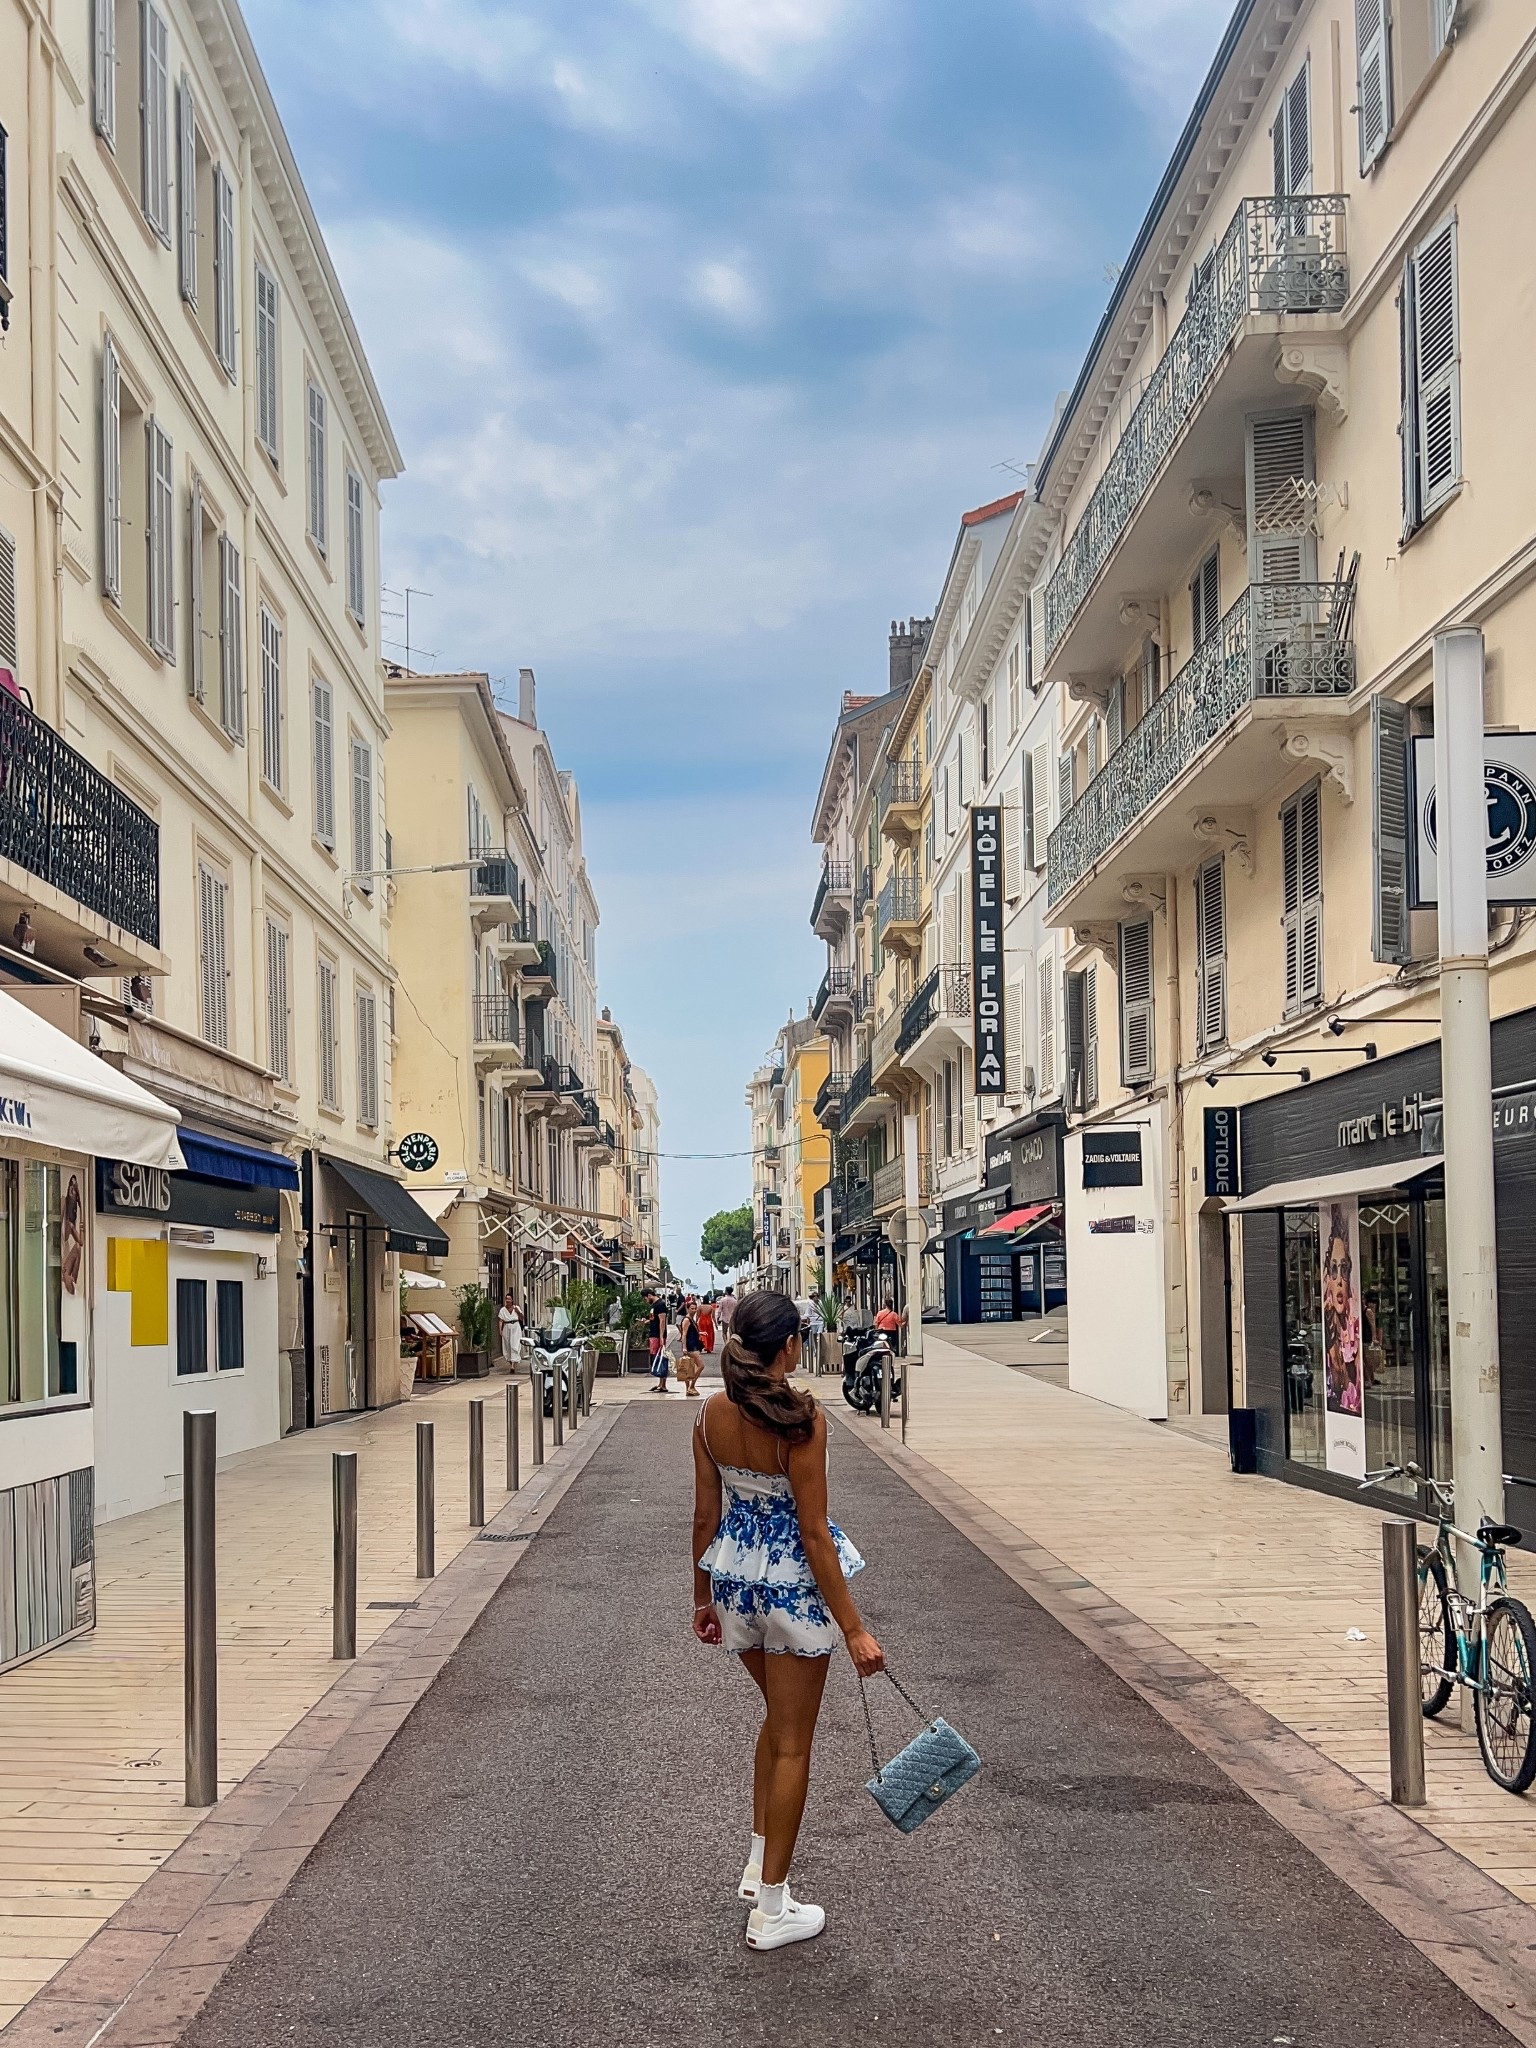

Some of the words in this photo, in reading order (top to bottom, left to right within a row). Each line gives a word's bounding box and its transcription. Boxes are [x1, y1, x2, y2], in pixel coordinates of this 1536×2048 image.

[977, 815, 997, 907] HÔTEL
[980, 920, 996, 952] LE
[979, 965, 1001, 1086] FLORIAN
[1338, 1114, 1377, 1147] marc
[1382, 1102, 1397, 1137] le
[1493, 1105, 1536, 1128] EUR
[1215, 1110, 1230, 1192] OPTIQUE
[117, 1162, 171, 1212] savills
